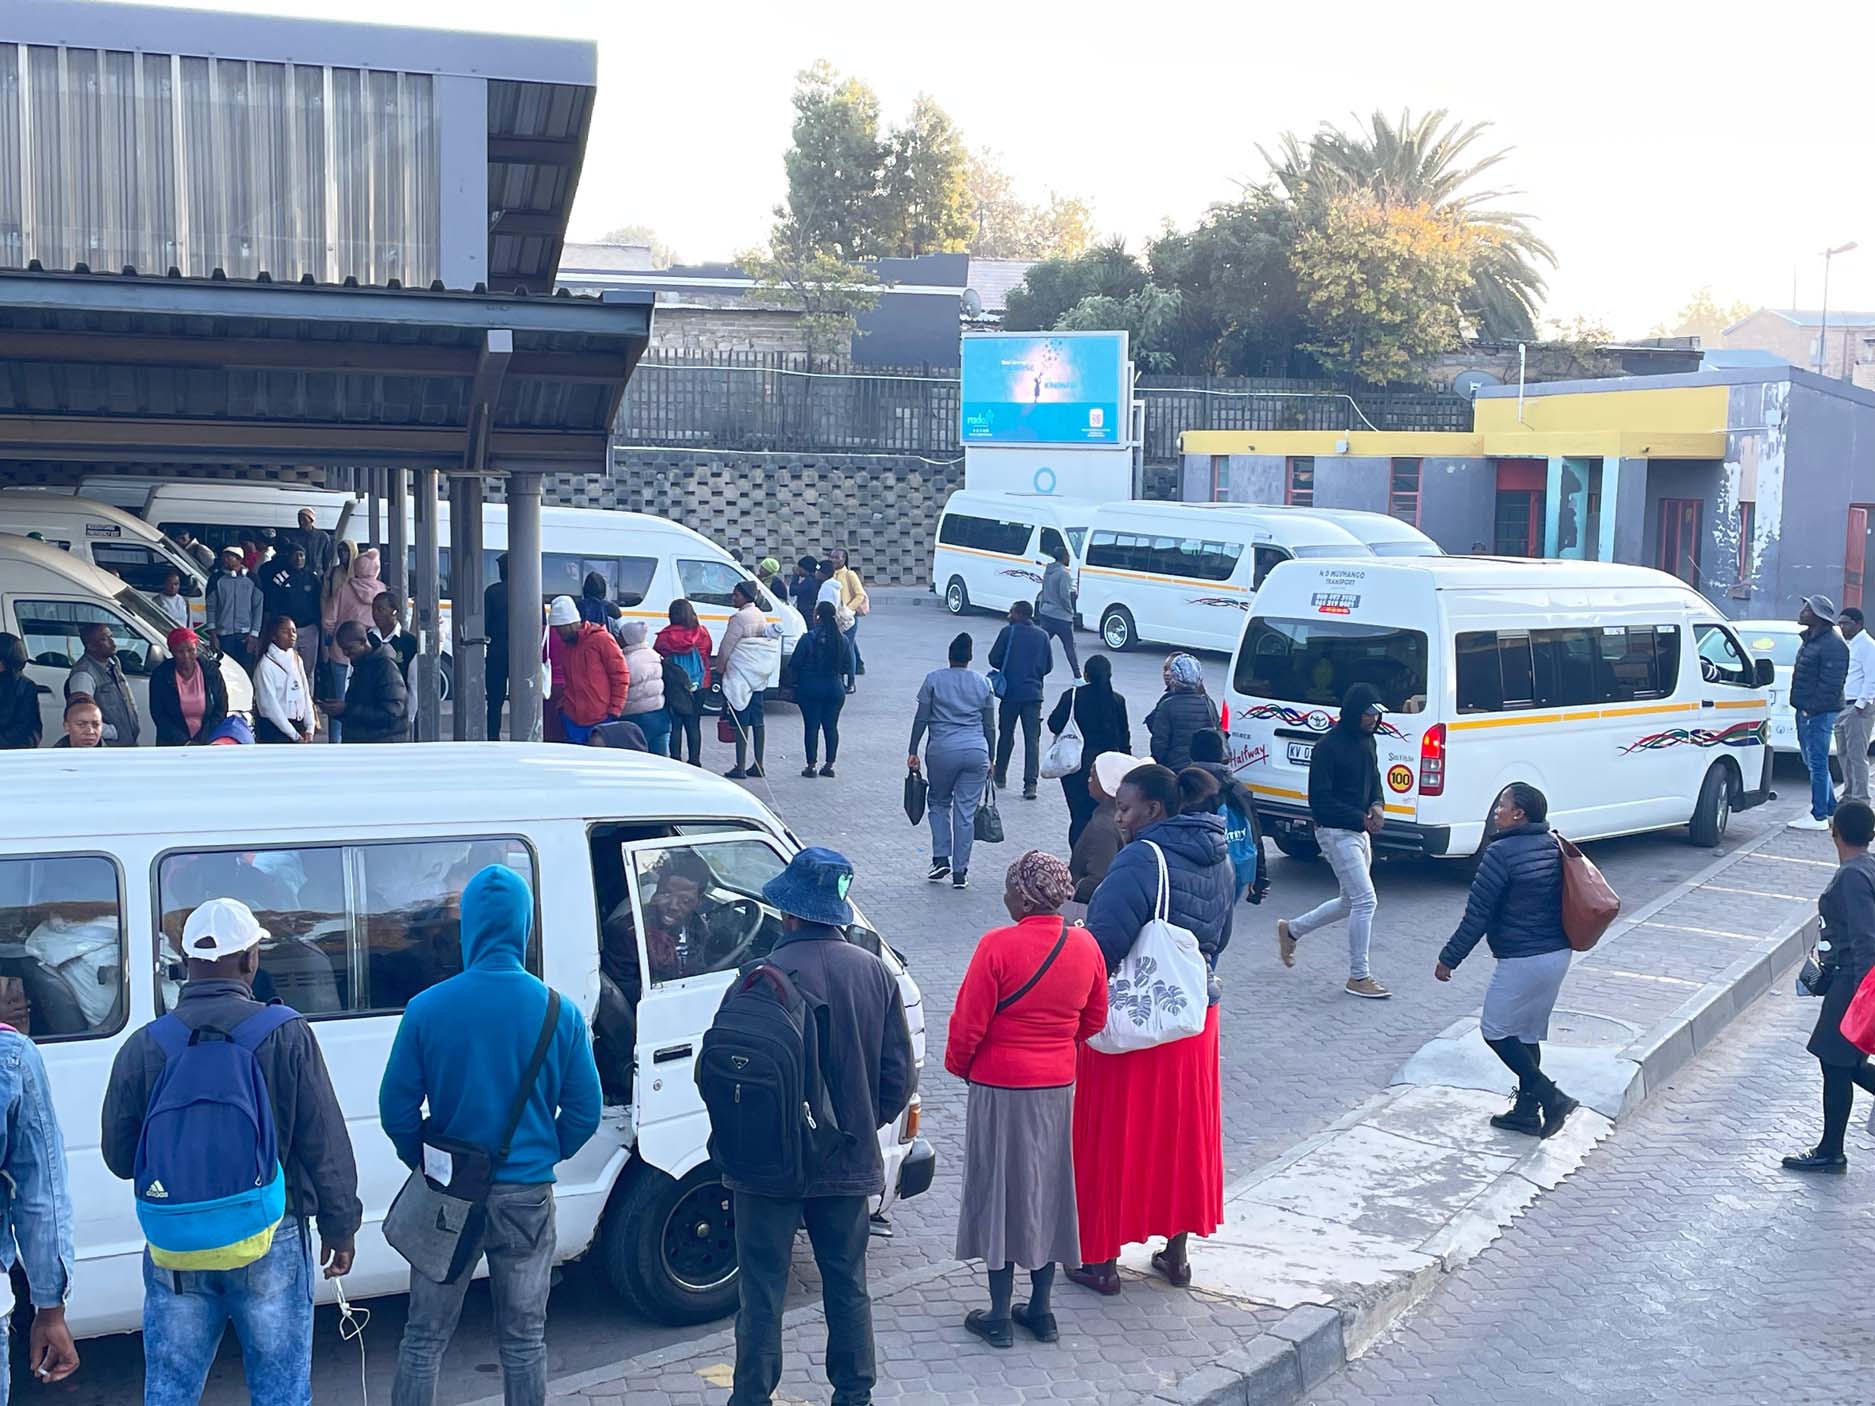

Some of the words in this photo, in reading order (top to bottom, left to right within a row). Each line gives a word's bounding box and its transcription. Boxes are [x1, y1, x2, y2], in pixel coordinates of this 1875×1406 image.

[1230, 744, 1267, 767] Halfway
[1289, 745, 1301, 758] KV
[1391, 772, 1410, 786] 100
